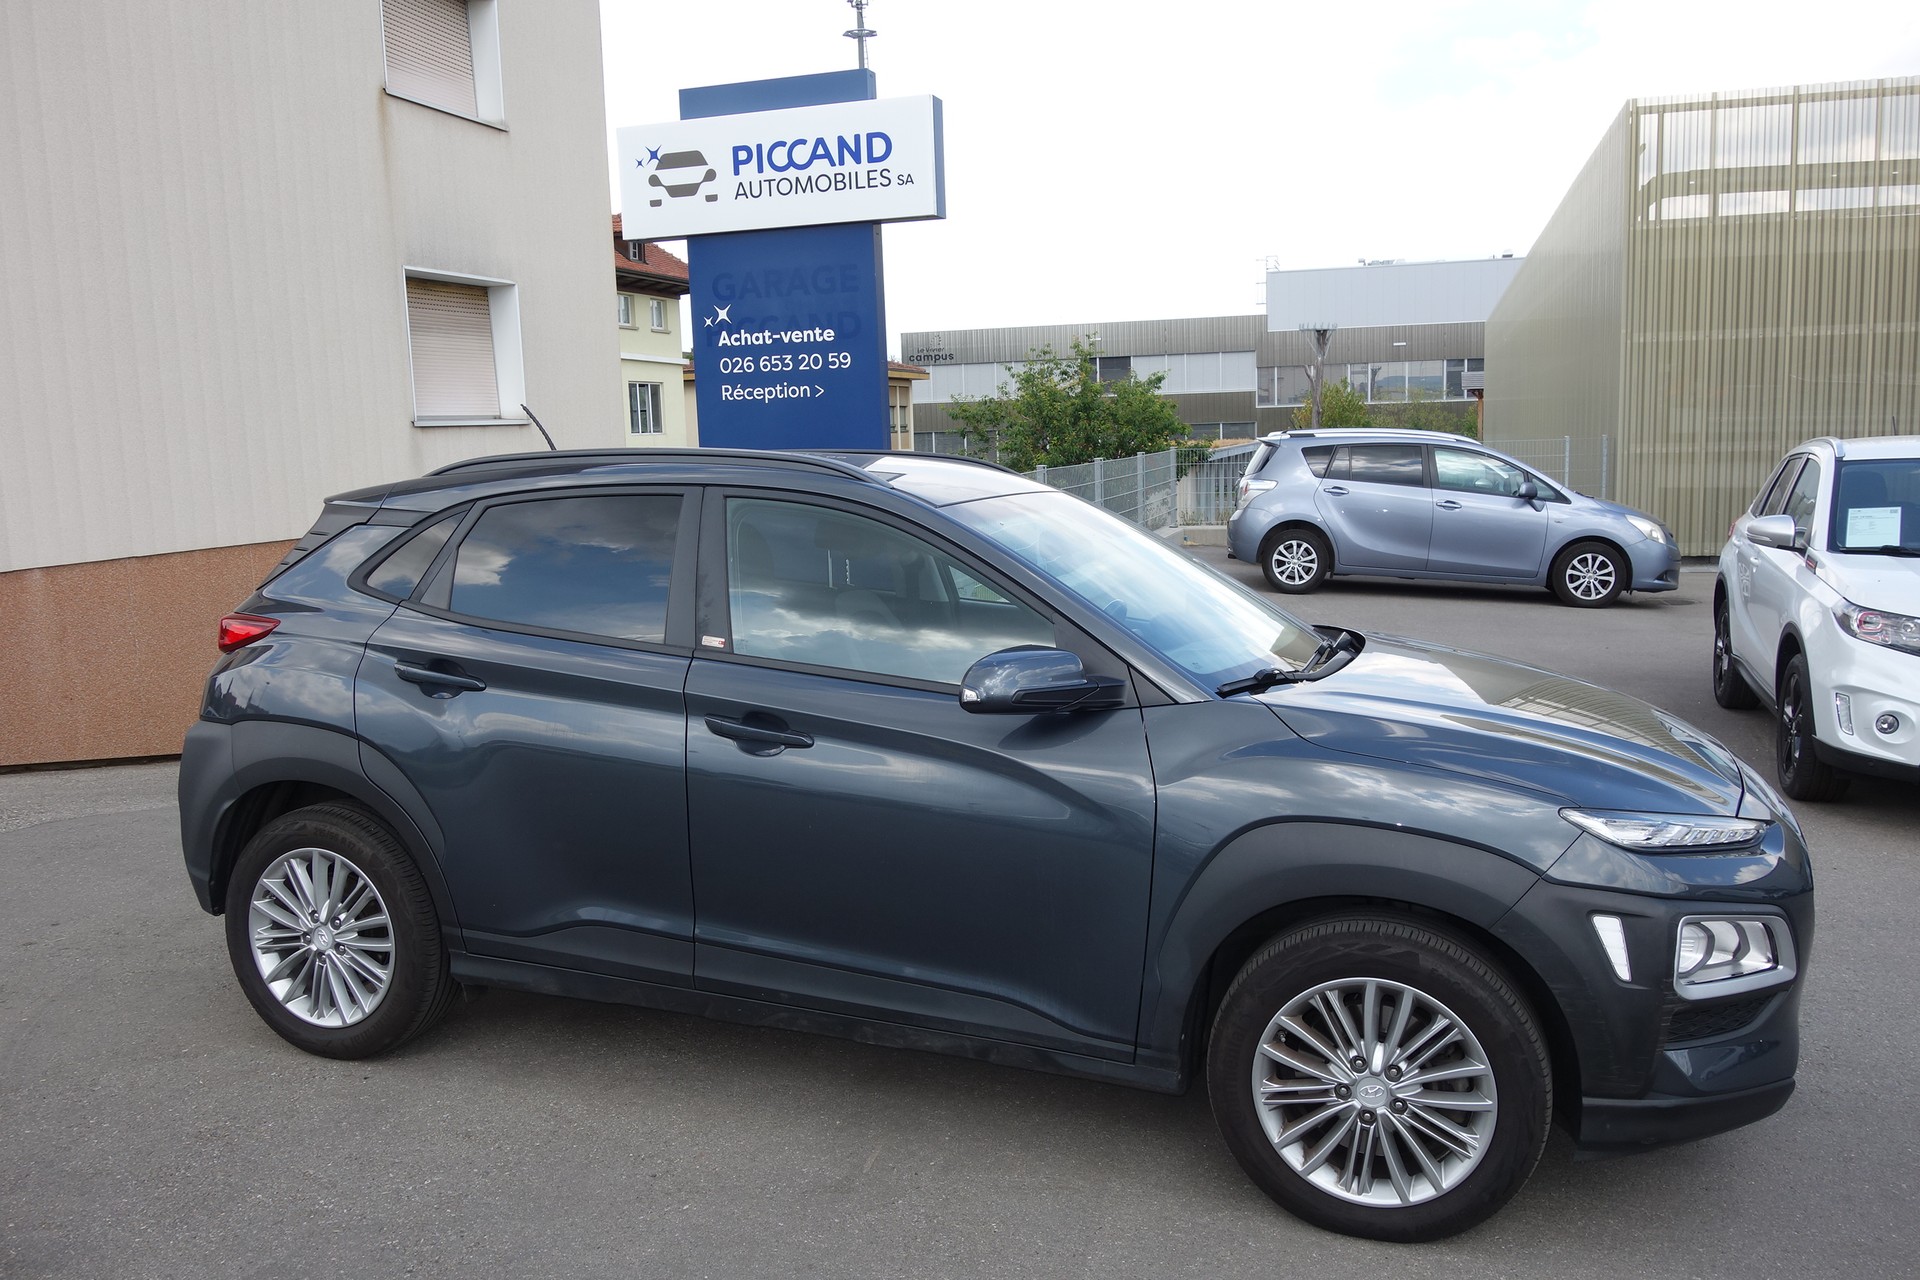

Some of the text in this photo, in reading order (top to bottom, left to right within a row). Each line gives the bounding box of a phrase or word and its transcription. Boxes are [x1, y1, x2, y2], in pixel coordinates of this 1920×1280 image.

[732, 131, 893, 176] PICCAND
[734, 168, 914, 200] AUTOMOBILES SA
[718, 327, 835, 347] Achat-vente
[719, 352, 851, 374] 026 653 20 59
[909, 353, 954, 363] campus
[721, 381, 811, 403] Réception
